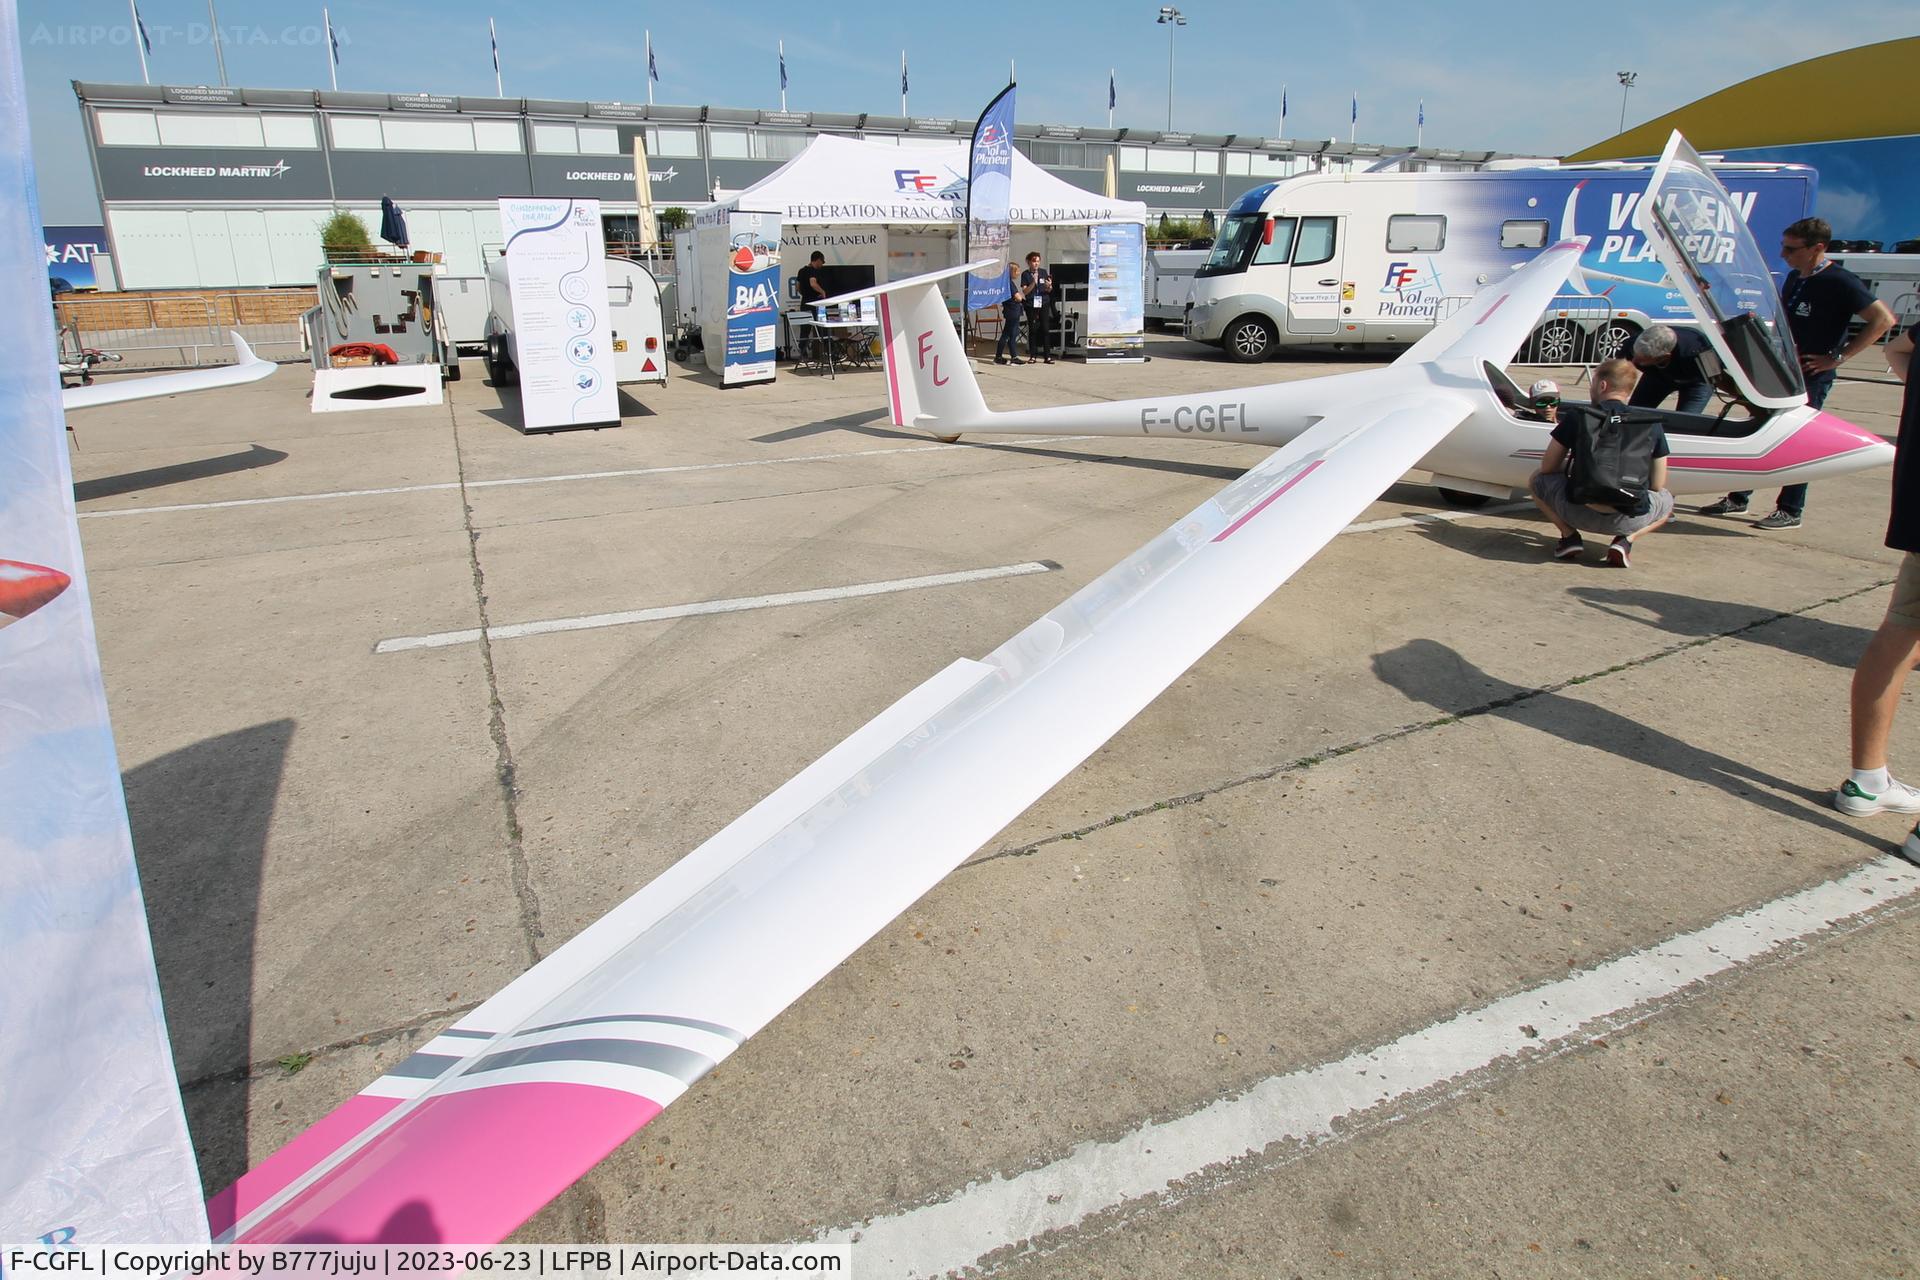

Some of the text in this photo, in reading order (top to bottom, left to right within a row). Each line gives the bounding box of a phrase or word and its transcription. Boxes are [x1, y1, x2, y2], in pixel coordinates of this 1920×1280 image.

[975, 153, 1010, 165] Planeur
[144, 166, 271, 178] LOCKHEED MARTIN
[566, 171, 663, 182] LOCKHEED MTIN
[1136, 185, 1196, 194] LOCKHEED MARTIN
[788, 203, 887, 218] FÉDÉRATION
[1009, 208, 1027, 220] OL
[1032, 208, 1049, 220] EN
[1053, 208, 1112, 221] PLANEUR
[823, 234, 877, 245] PLANEUR
[1598, 235, 1736, 264] PLAEUR
[1384, 262, 1418, 291] FF
[734, 283, 769, 311] BIA
[972, 287, 1005, 296] www.ffvp.f
[1398, 290, 1438, 304] Vol en
[1141, 403, 1260, 434] F-CGFL
